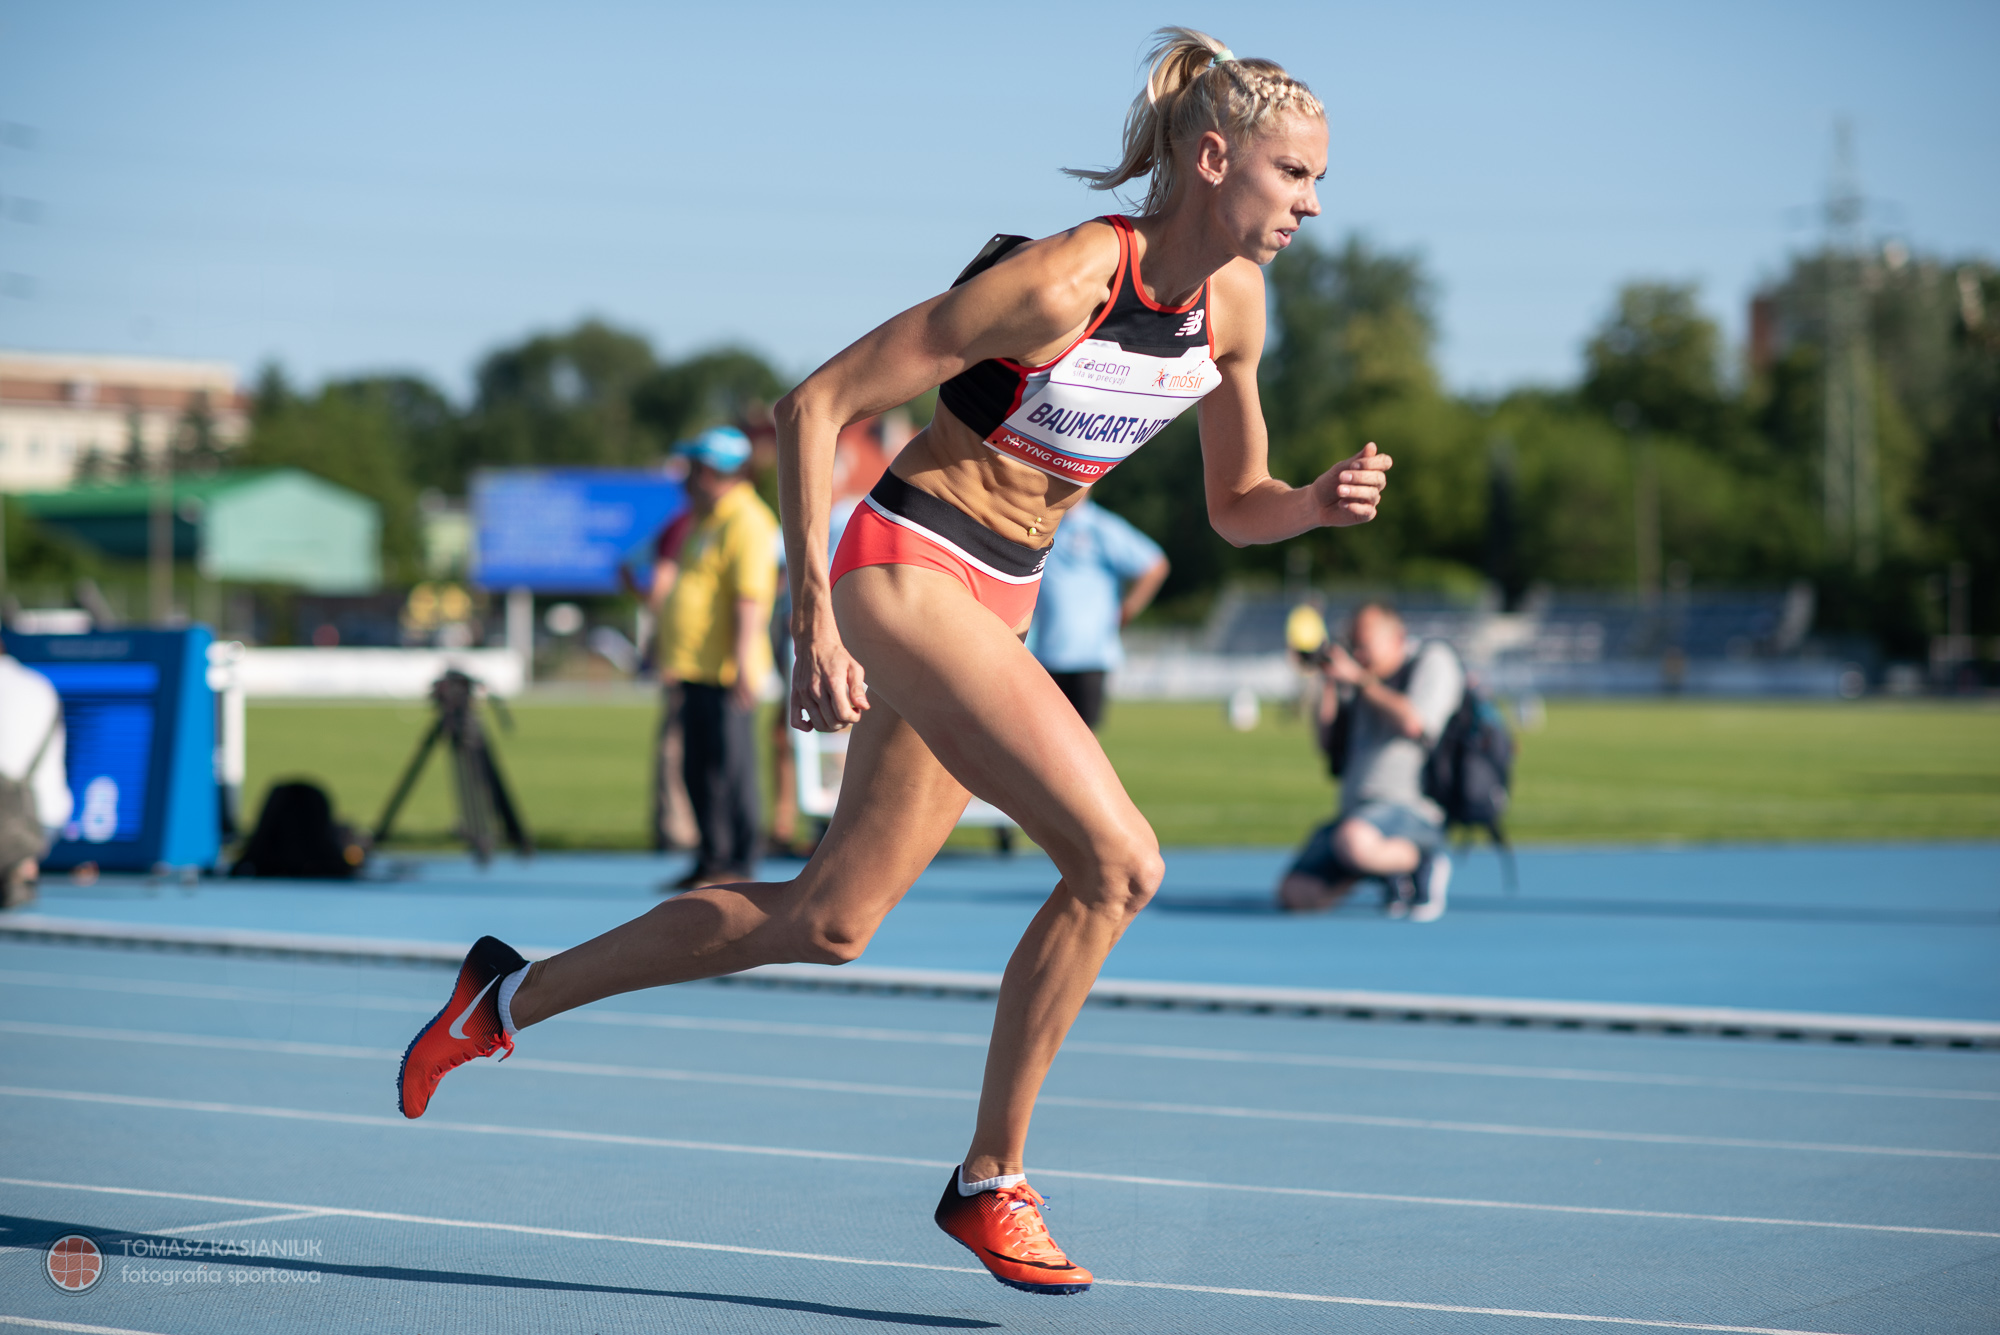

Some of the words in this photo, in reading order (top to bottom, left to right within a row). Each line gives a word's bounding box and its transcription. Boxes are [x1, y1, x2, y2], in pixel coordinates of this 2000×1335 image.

[1168, 372, 1205, 389] mosir
[1026, 402, 1176, 445] BAUMGART-WIT
[1052, 457, 1100, 475] GWIAZD
